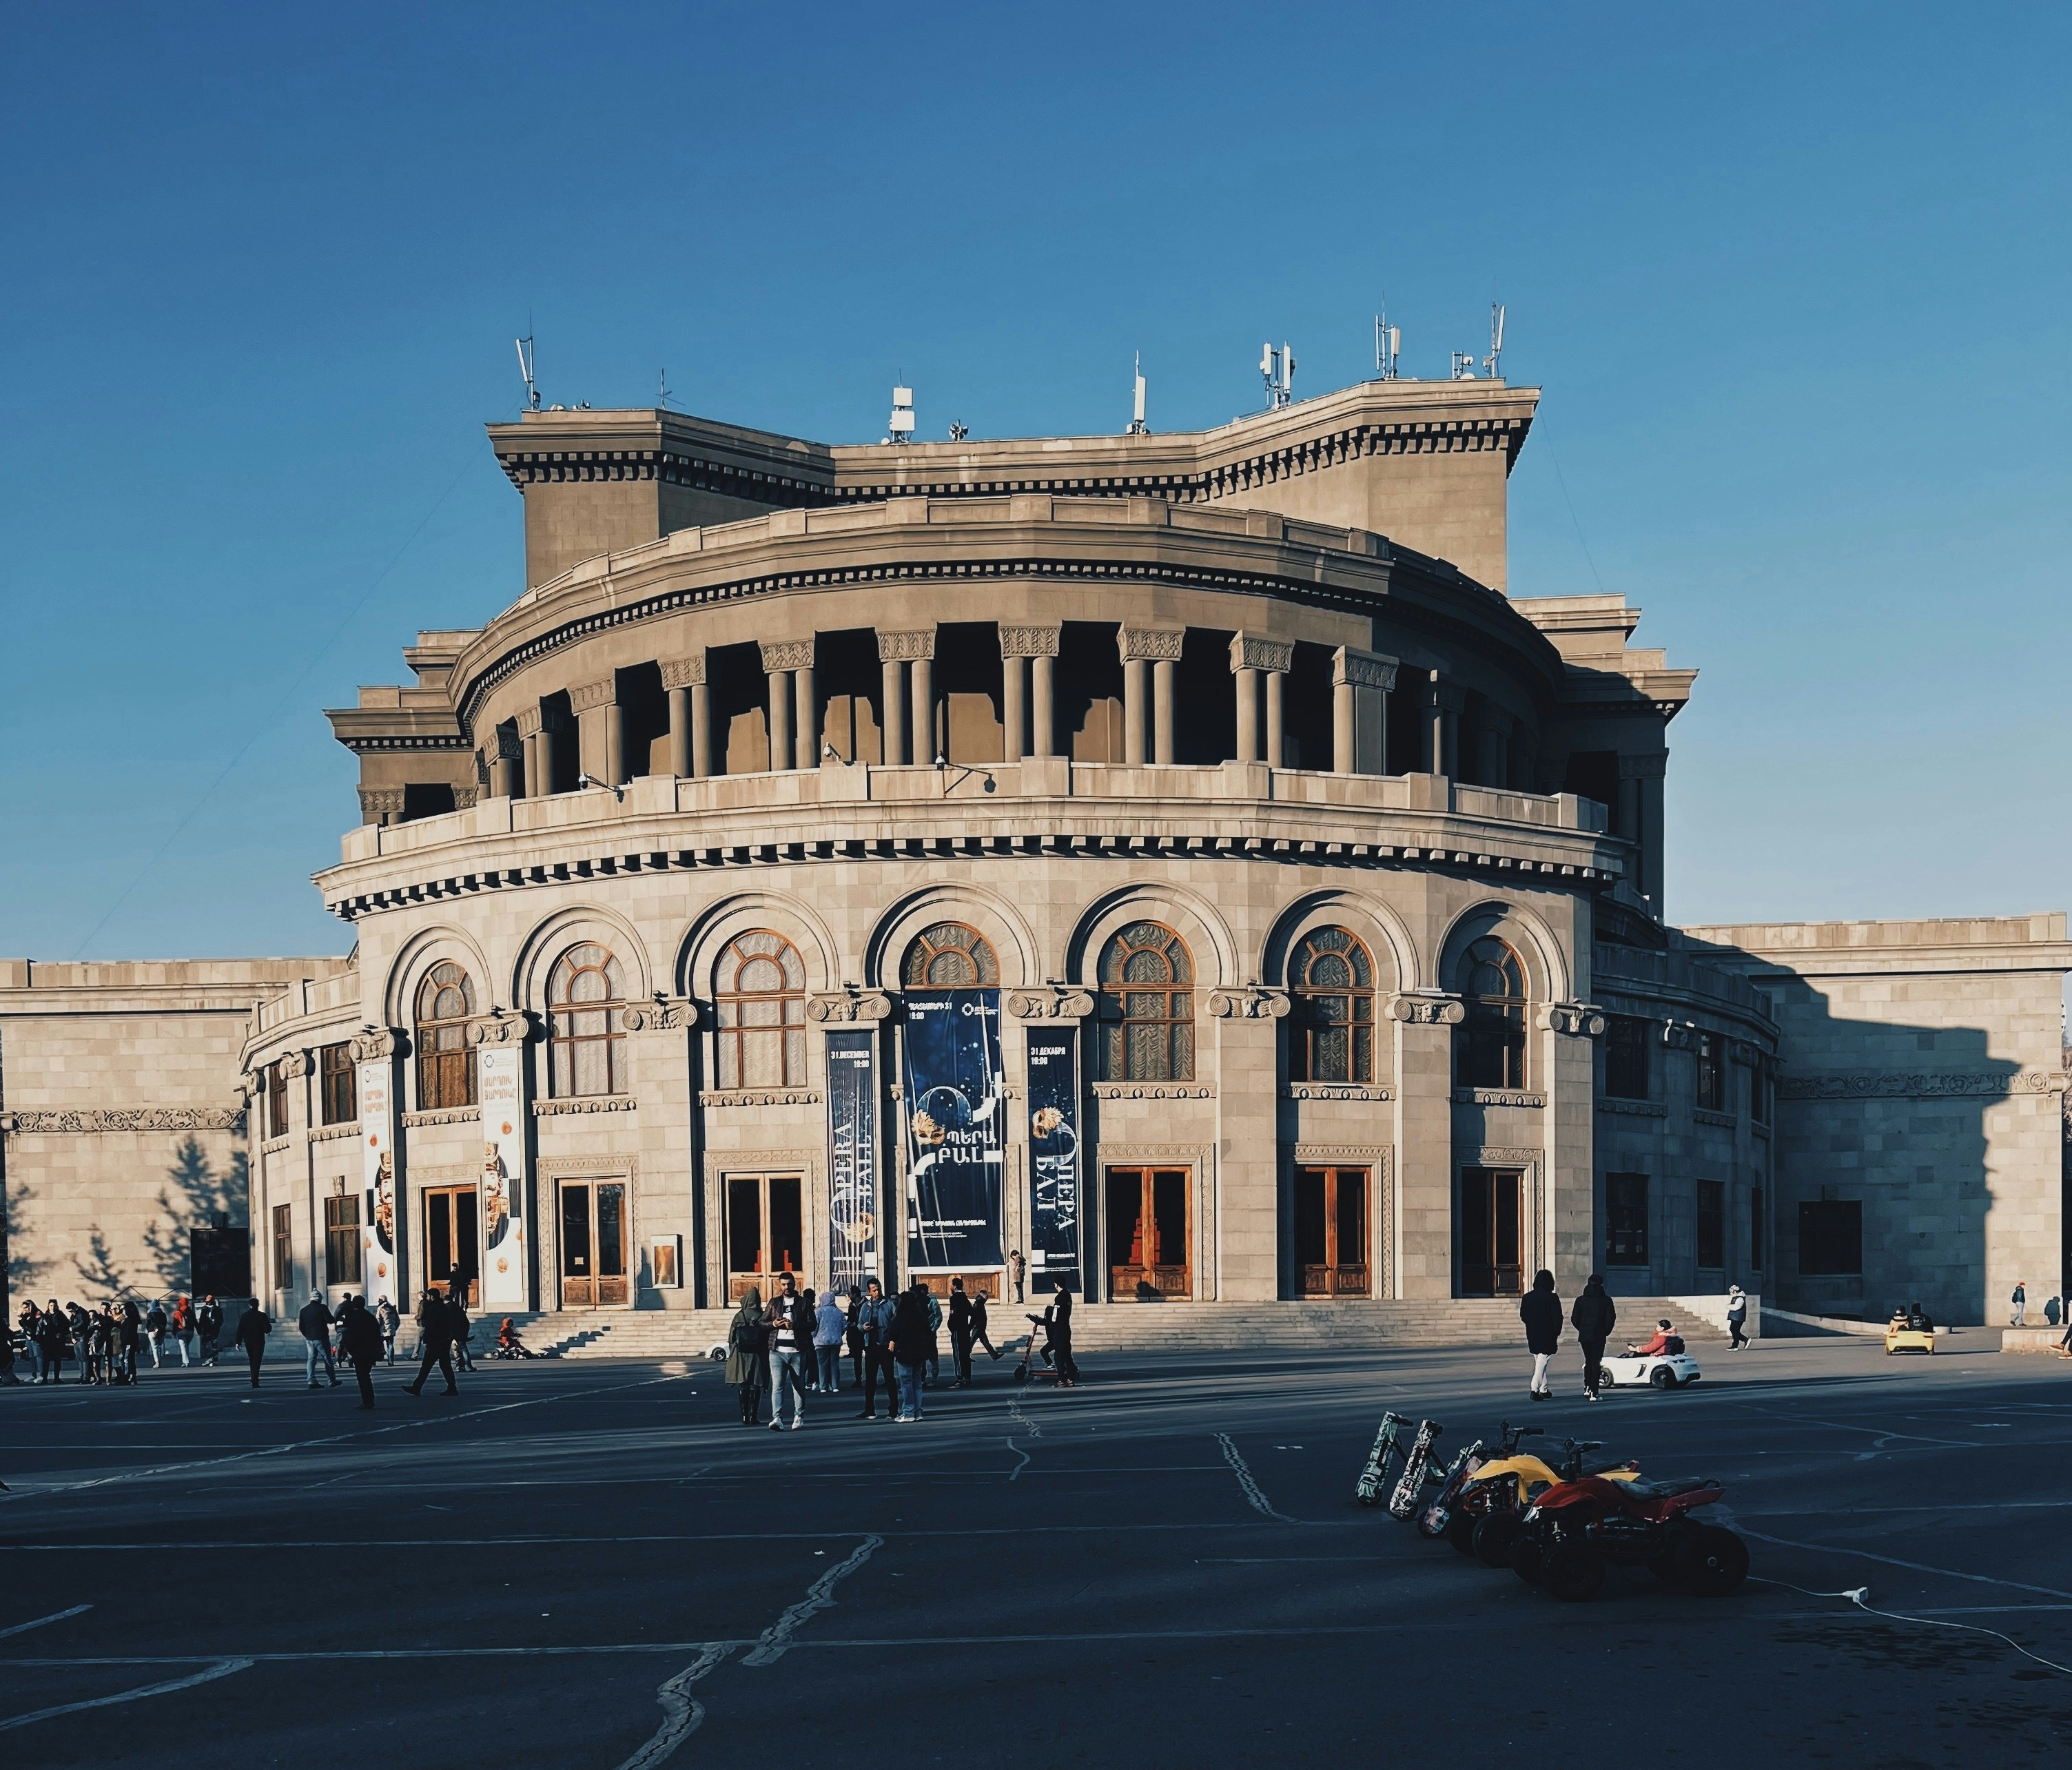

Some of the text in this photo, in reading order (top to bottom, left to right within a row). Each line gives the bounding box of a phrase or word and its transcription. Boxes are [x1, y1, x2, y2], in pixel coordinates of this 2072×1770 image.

[1031, 1047, 1038, 1056] 31
[1031, 1057, 1048, 1065] 19:00
[1036, 1155, 1056, 1211] БАЛ
